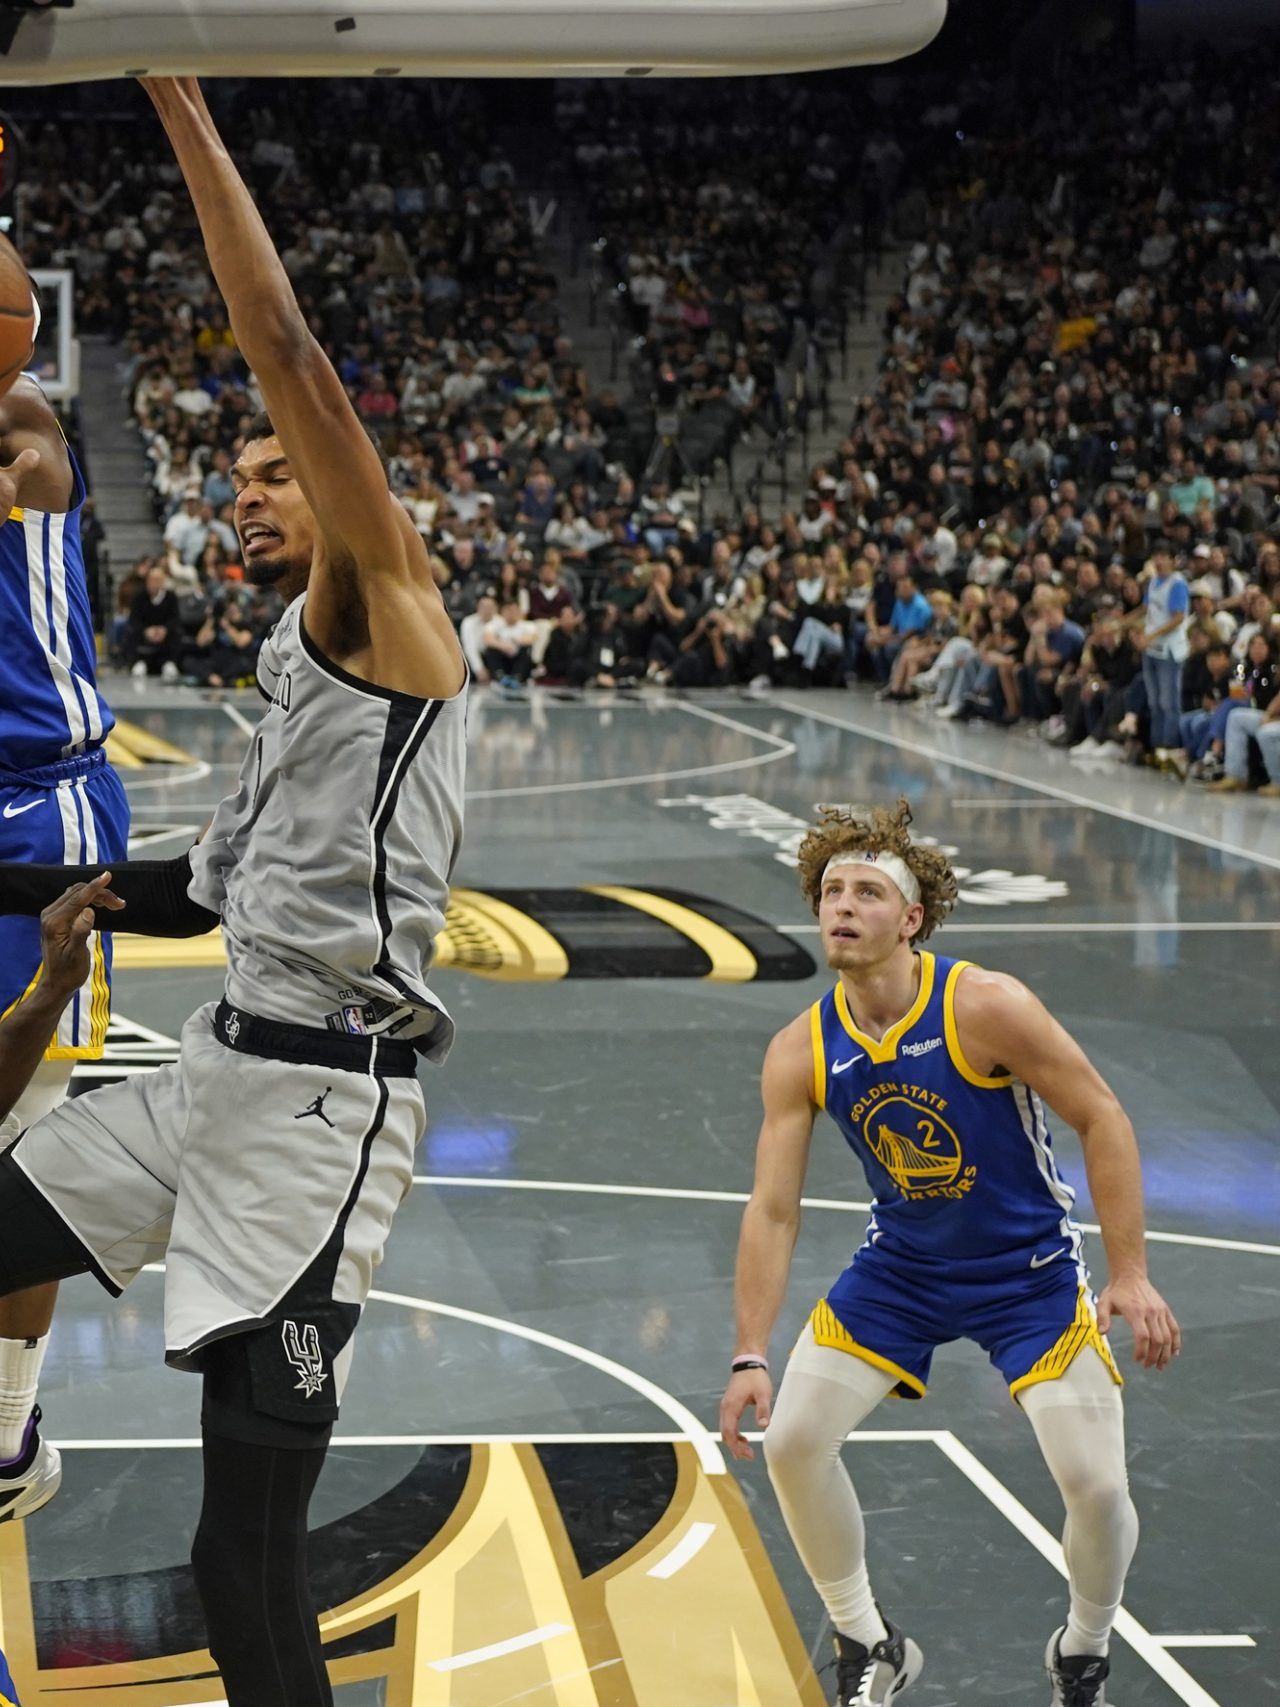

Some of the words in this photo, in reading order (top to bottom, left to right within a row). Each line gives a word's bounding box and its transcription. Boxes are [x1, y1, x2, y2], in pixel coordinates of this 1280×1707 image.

[901, 1037, 943, 1057] Rakuten
[851, 1082, 898, 1122] GOLDEN
[902, 1083, 948, 1112] STATE
[917, 1119, 941, 1148] 2
